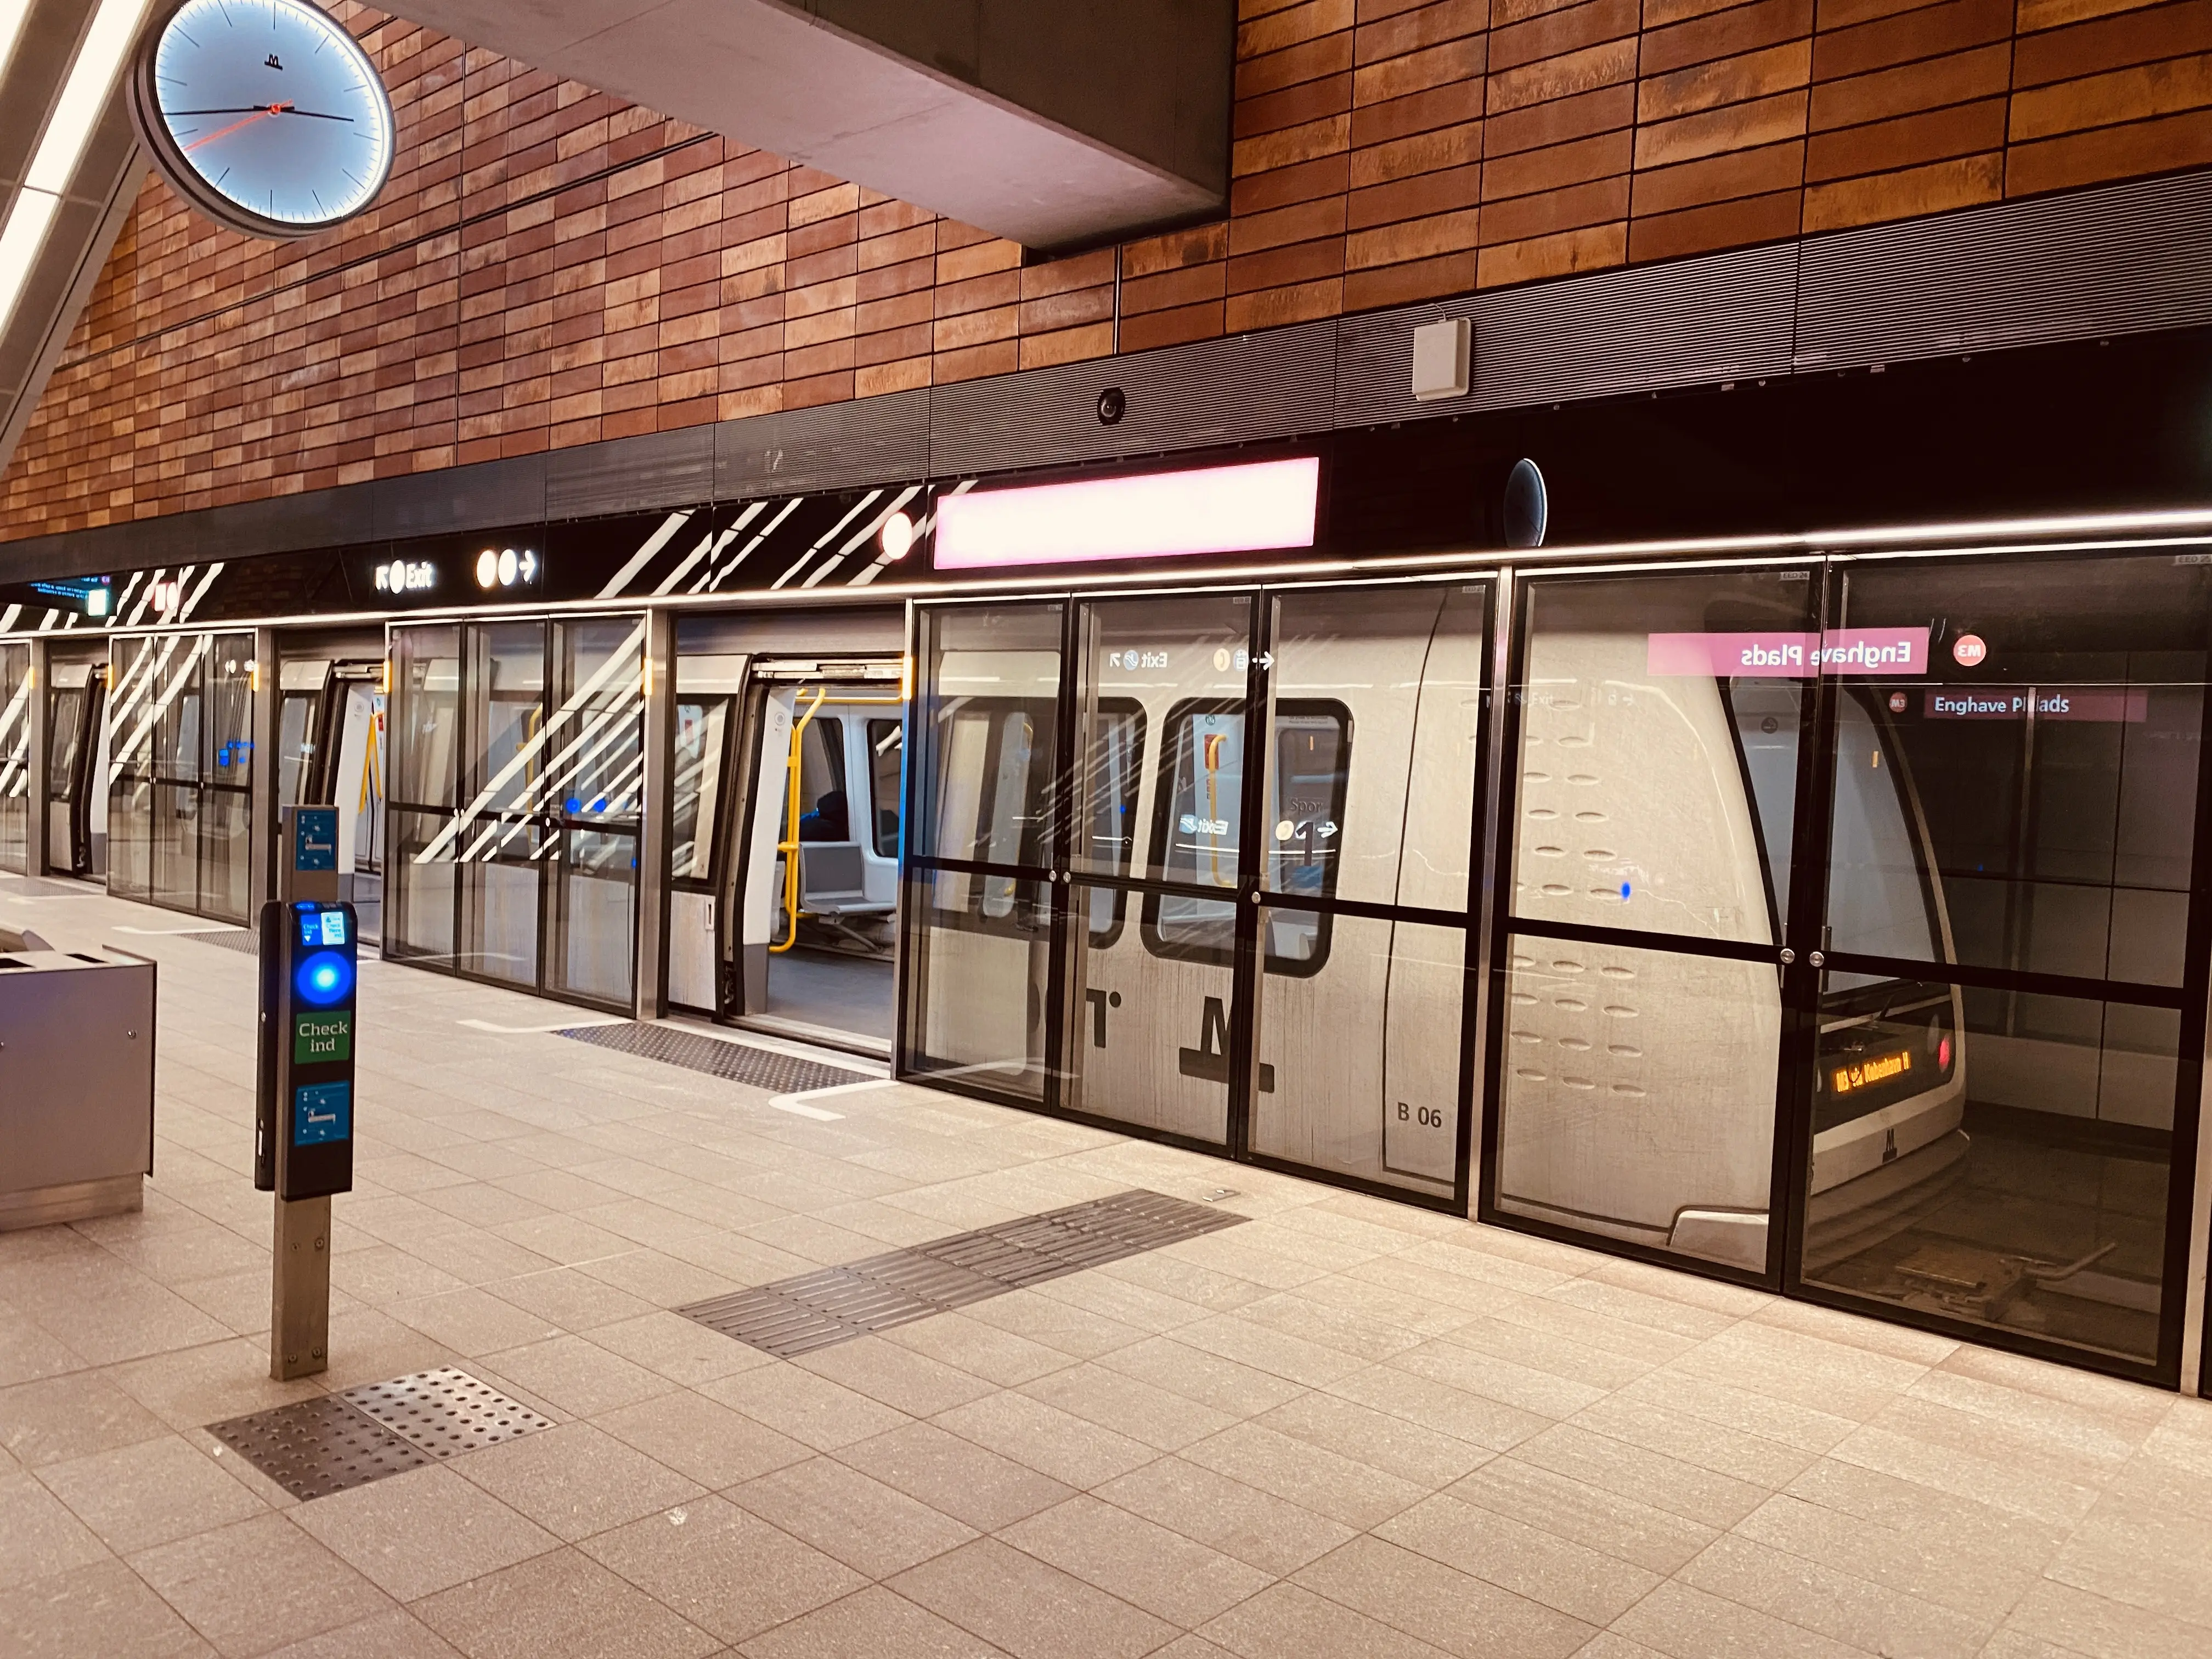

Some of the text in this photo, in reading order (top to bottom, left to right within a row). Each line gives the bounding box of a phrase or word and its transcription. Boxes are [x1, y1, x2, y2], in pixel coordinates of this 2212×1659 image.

[1934, 696, 2007, 715] Enghave
[1290, 797, 1324, 816] Spor
[299, 1020, 348, 1037] Check
[310, 1038, 335, 1053] ind
[1397, 1101, 1442, 1128] B 06
